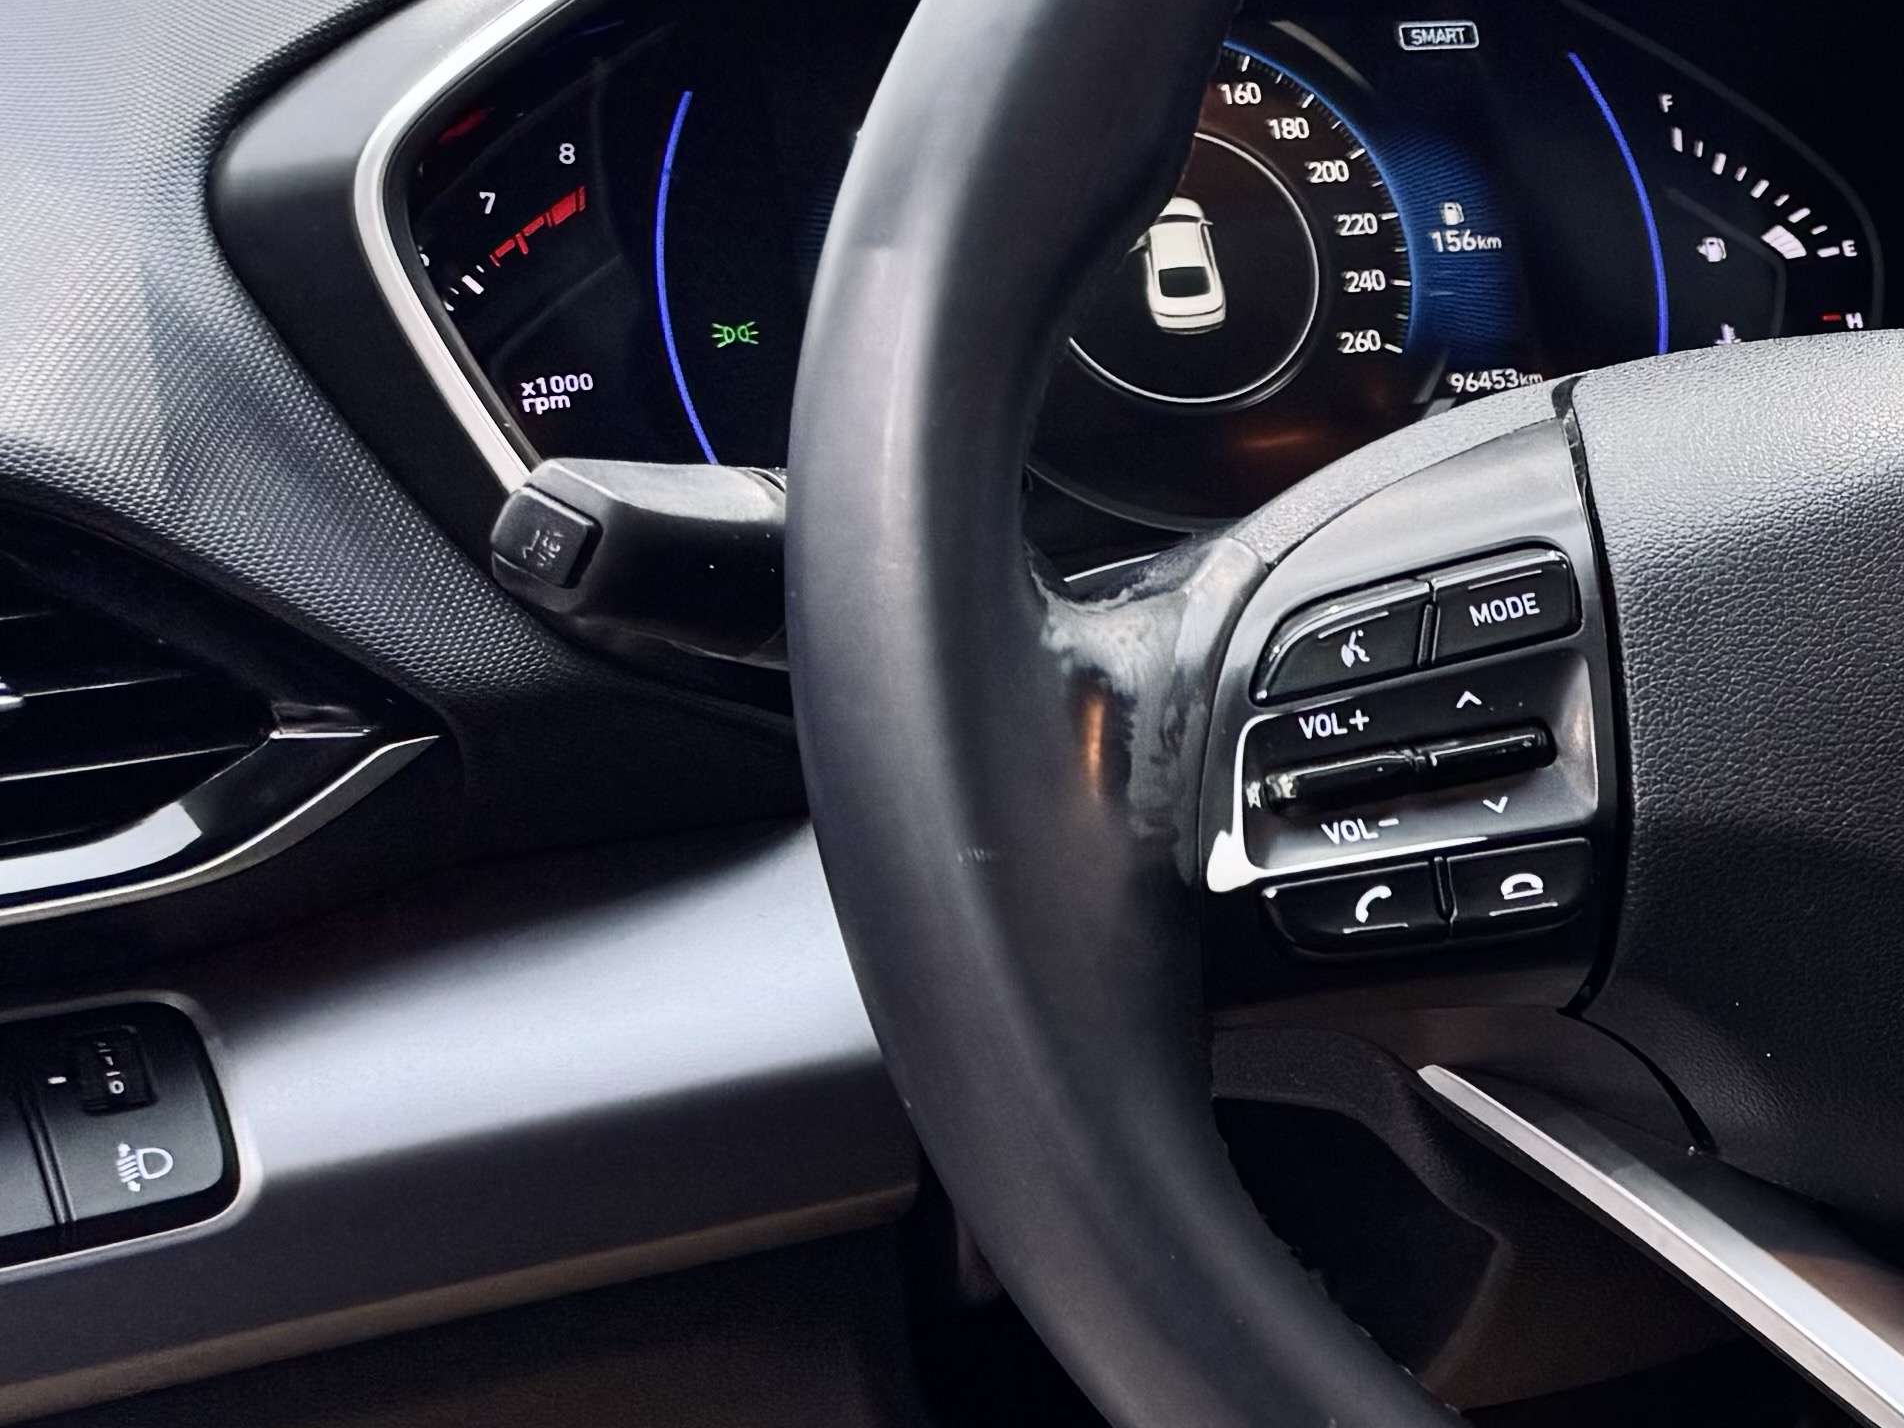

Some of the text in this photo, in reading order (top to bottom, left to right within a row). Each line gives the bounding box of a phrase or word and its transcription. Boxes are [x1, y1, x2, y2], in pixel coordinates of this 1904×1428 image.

[1411, 26, 1465, 45] SMART
[1221, 82, 1261, 105] 160
[1659, 93, 1673, 113] F
[1269, 117, 1309, 139] 180
[558, 143, 576, 164] 8
[1308, 160, 1349, 183] 200
[479, 191, 496, 214] 7
[1337, 213, 1378, 236] 220
[1841, 240, 1858, 257] E
[1345, 270, 1386, 293] 240
[1845, 312, 1864, 329] H
[1339, 329, 1381, 353] 260
[521, 373, 593, 397] x1000
[522, 394, 571, 414] rpm
[1469, 592, 1540, 627] MODE
